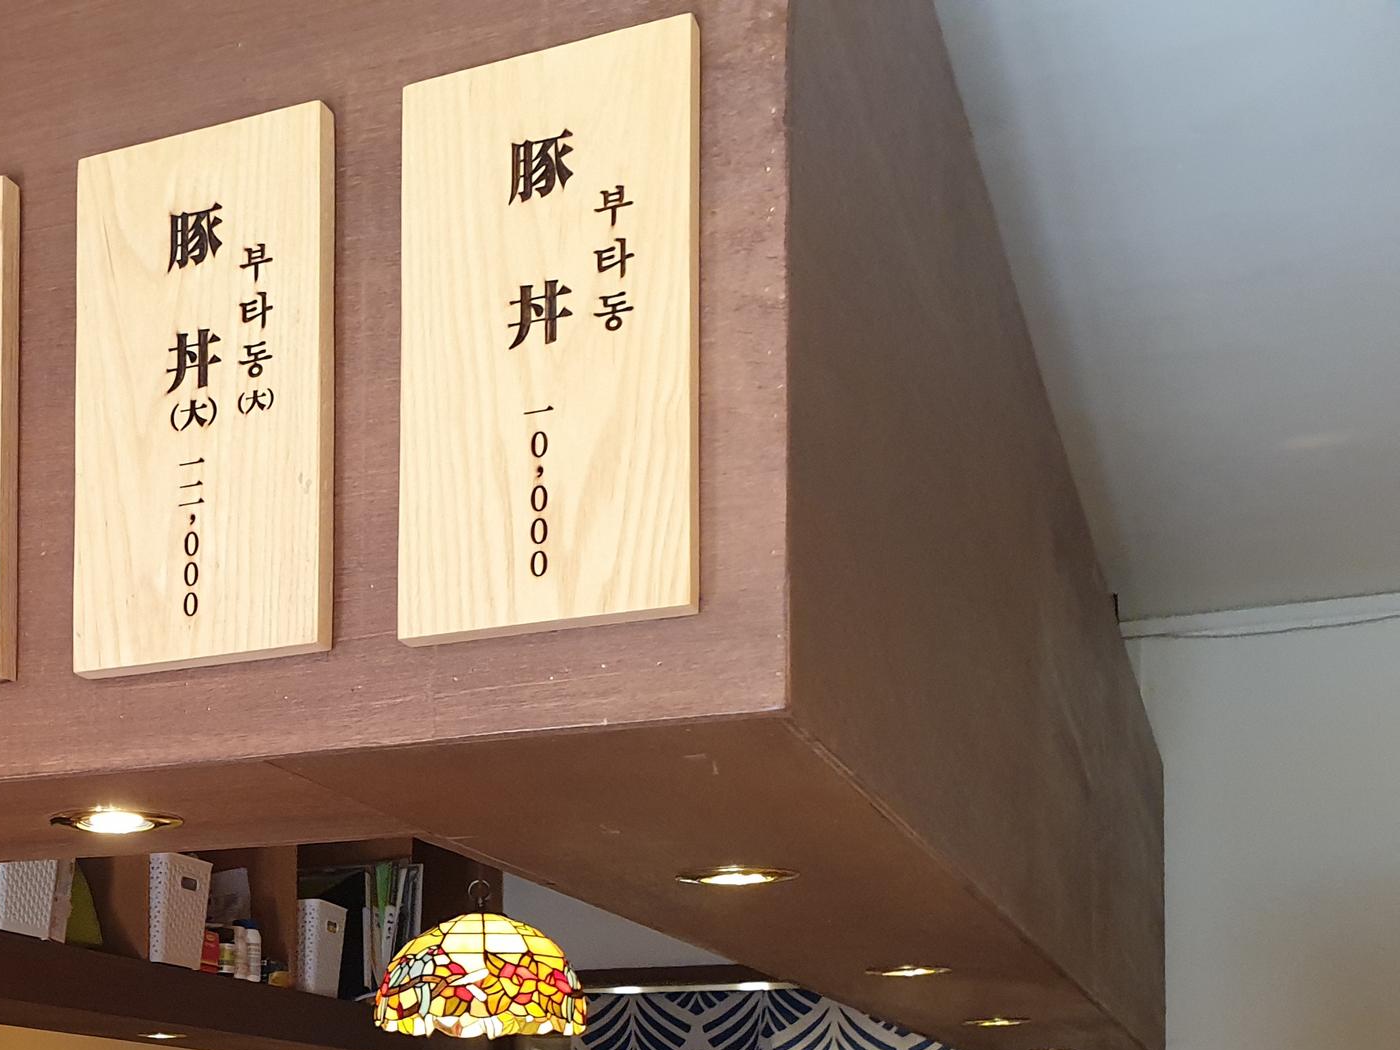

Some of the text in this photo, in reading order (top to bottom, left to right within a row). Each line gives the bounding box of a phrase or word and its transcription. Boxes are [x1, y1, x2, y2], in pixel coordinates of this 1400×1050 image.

[508, 129, 573, 349] 豚丼
[594, 185, 634, 331] 부타동
[238, 244, 274, 414] 부타동(大)
